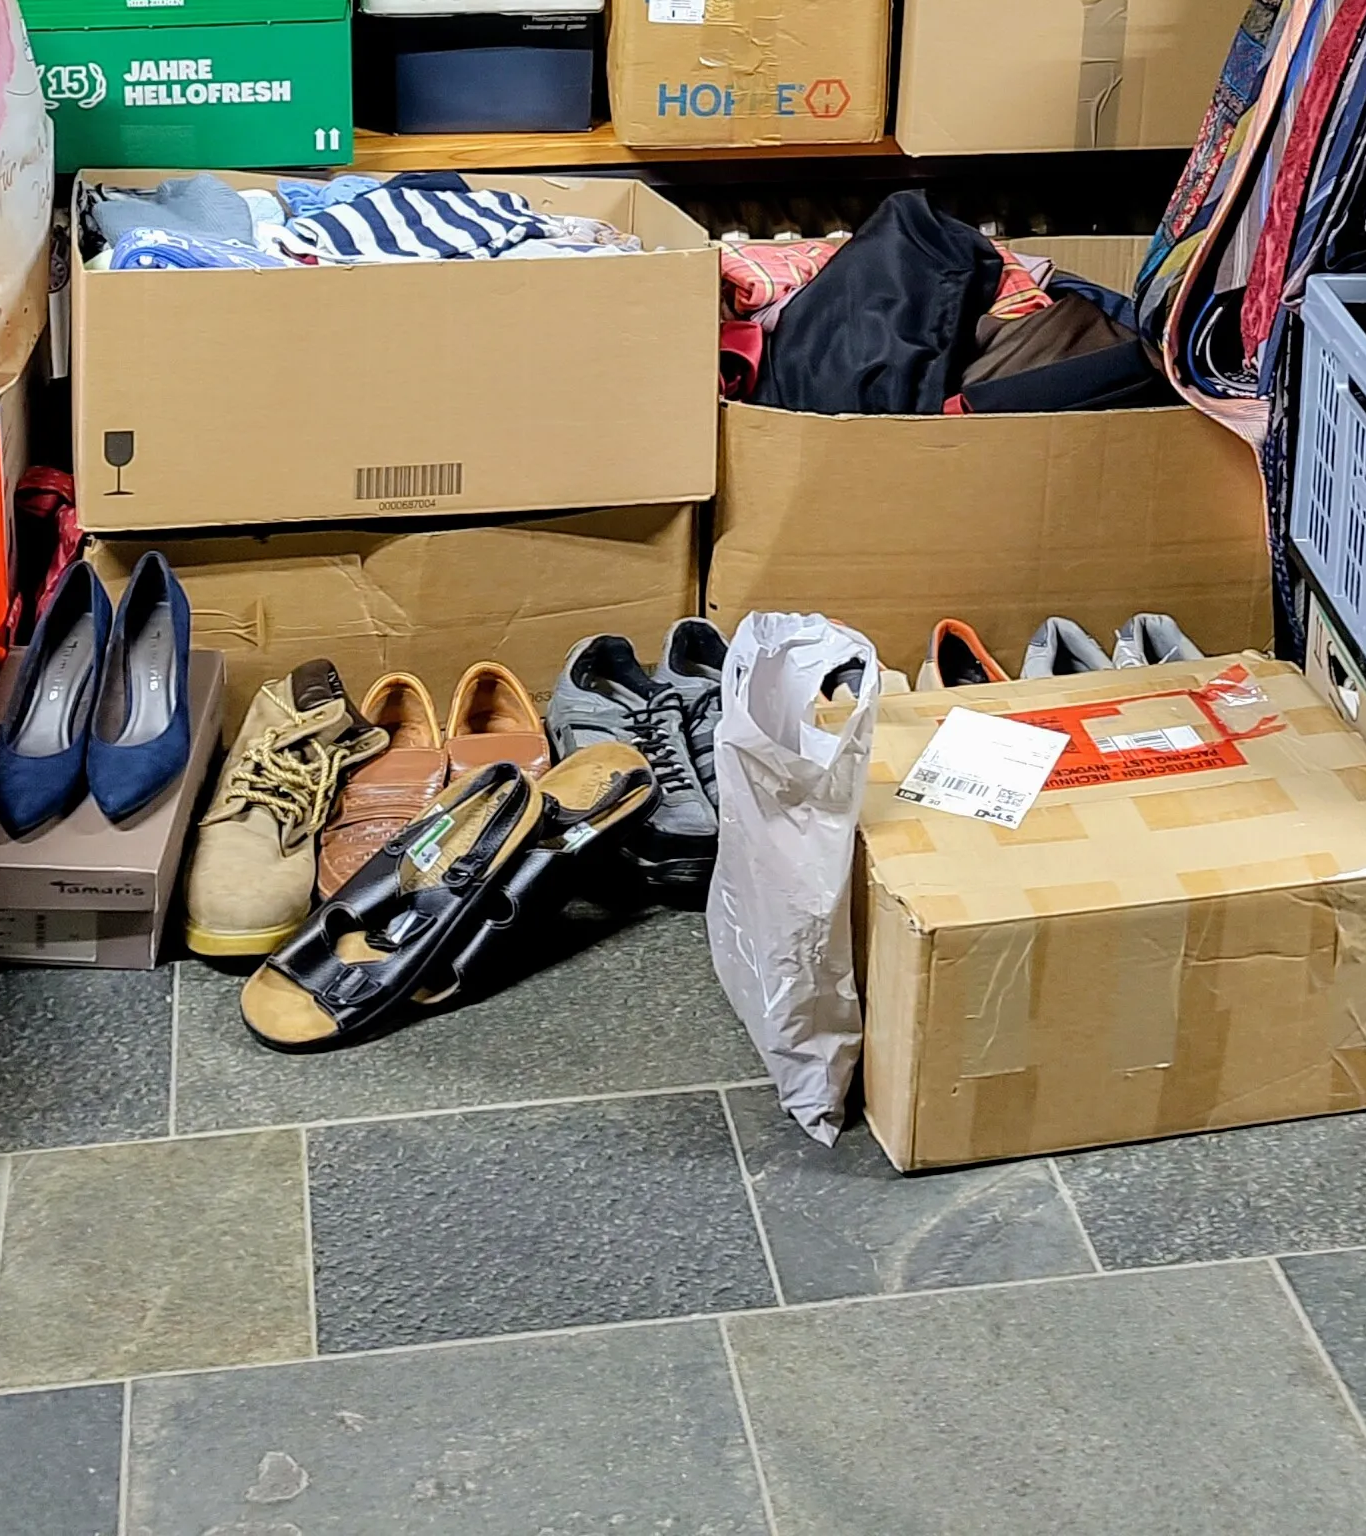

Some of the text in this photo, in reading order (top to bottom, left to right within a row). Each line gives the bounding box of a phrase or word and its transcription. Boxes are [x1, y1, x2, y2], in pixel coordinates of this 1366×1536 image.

[123, 59, 213, 82] JAHRE
[48, 67, 87, 99] 15
[124, 80, 291, 107] HELLOFRESH
[1045, 772, 1111, 788] RECHNU
[50, 880, 146, 897] Tamaris
